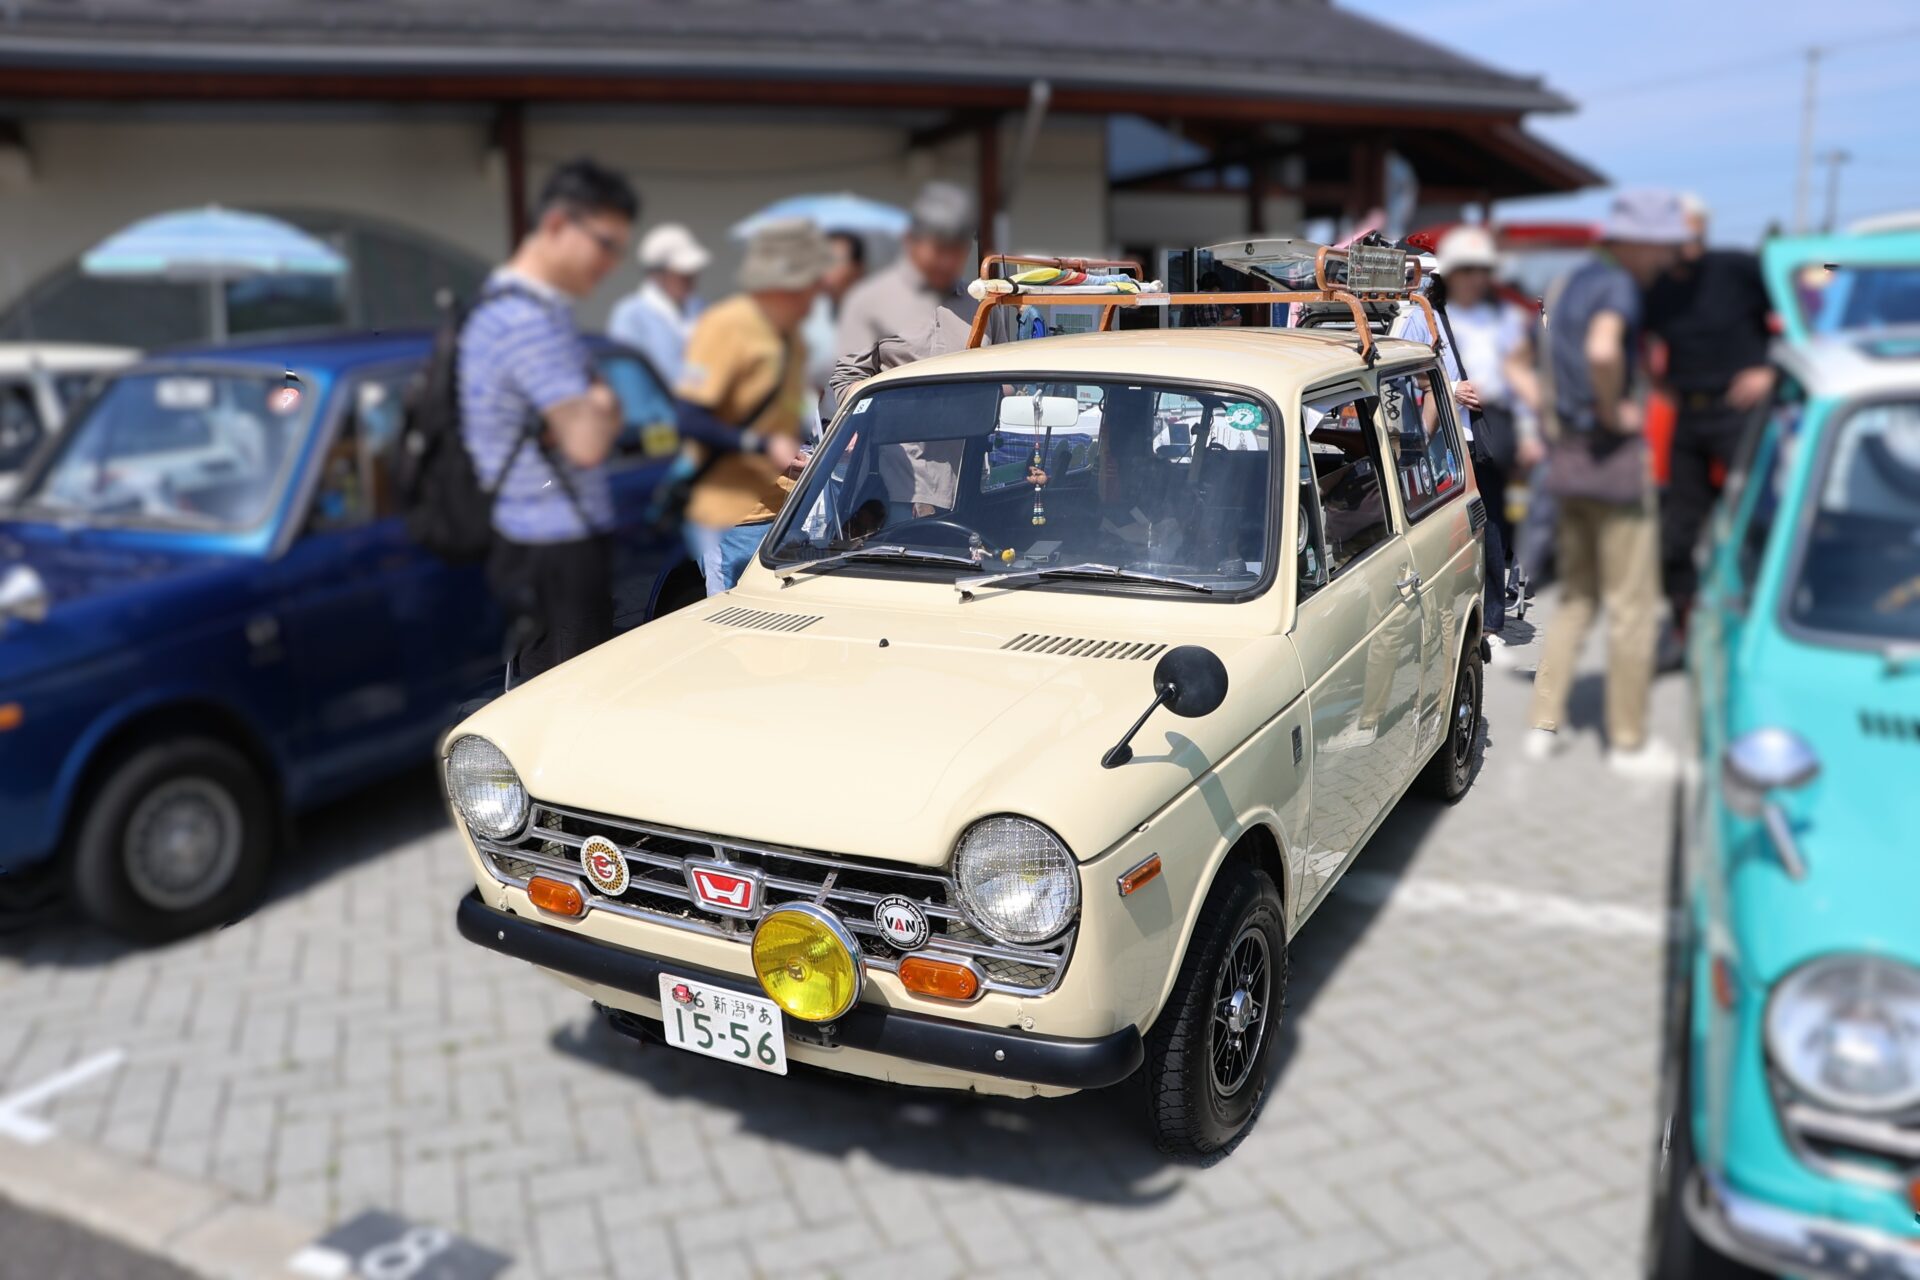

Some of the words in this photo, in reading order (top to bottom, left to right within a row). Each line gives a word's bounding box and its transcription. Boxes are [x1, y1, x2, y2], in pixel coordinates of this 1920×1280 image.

[1240, 412, 1248, 421] 7
[885, 916, 916, 933] VAN
[713, 995, 746, 1019] 新潟
[758, 1006, 772, 1026] あ
[676, 1008, 777, 1066] 15-56
